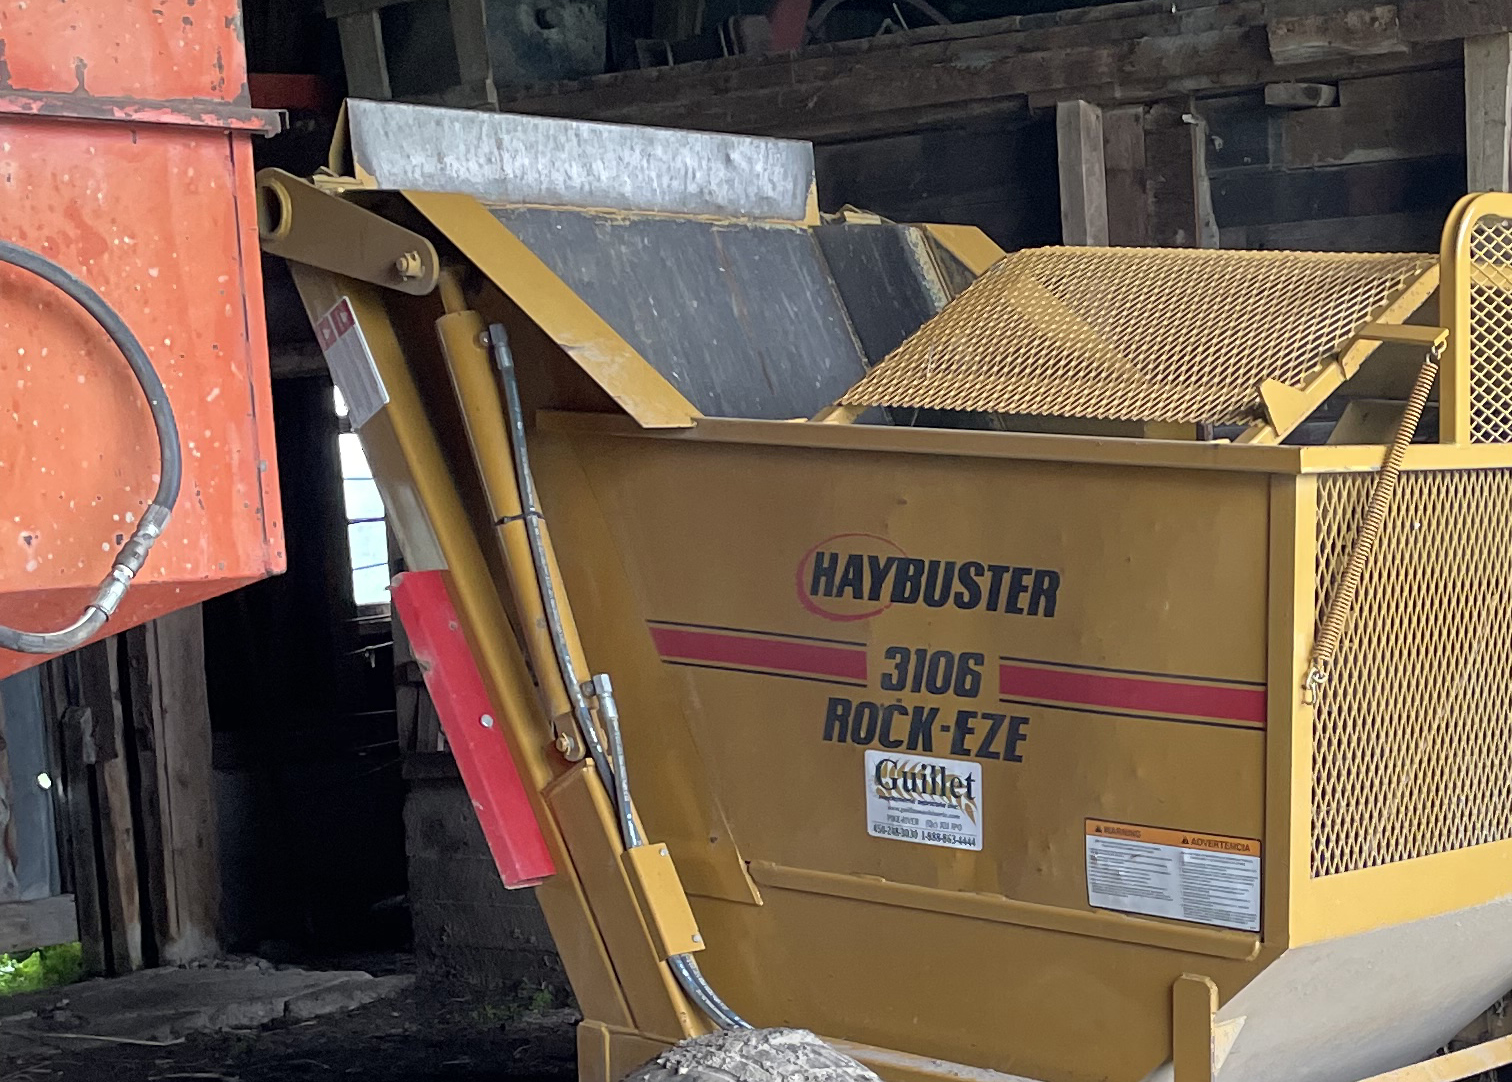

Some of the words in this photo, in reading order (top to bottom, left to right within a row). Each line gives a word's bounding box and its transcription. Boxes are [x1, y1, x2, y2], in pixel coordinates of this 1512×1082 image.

[810, 552, 1061, 617] HAYBUSTER
[880, 646, 985, 699] 3106
[822, 697, 1031, 762] ROCK-EZE
[874, 758, 976, 801] Guillet
[1190, 836, 1251, 852] ADVERTENCIA
